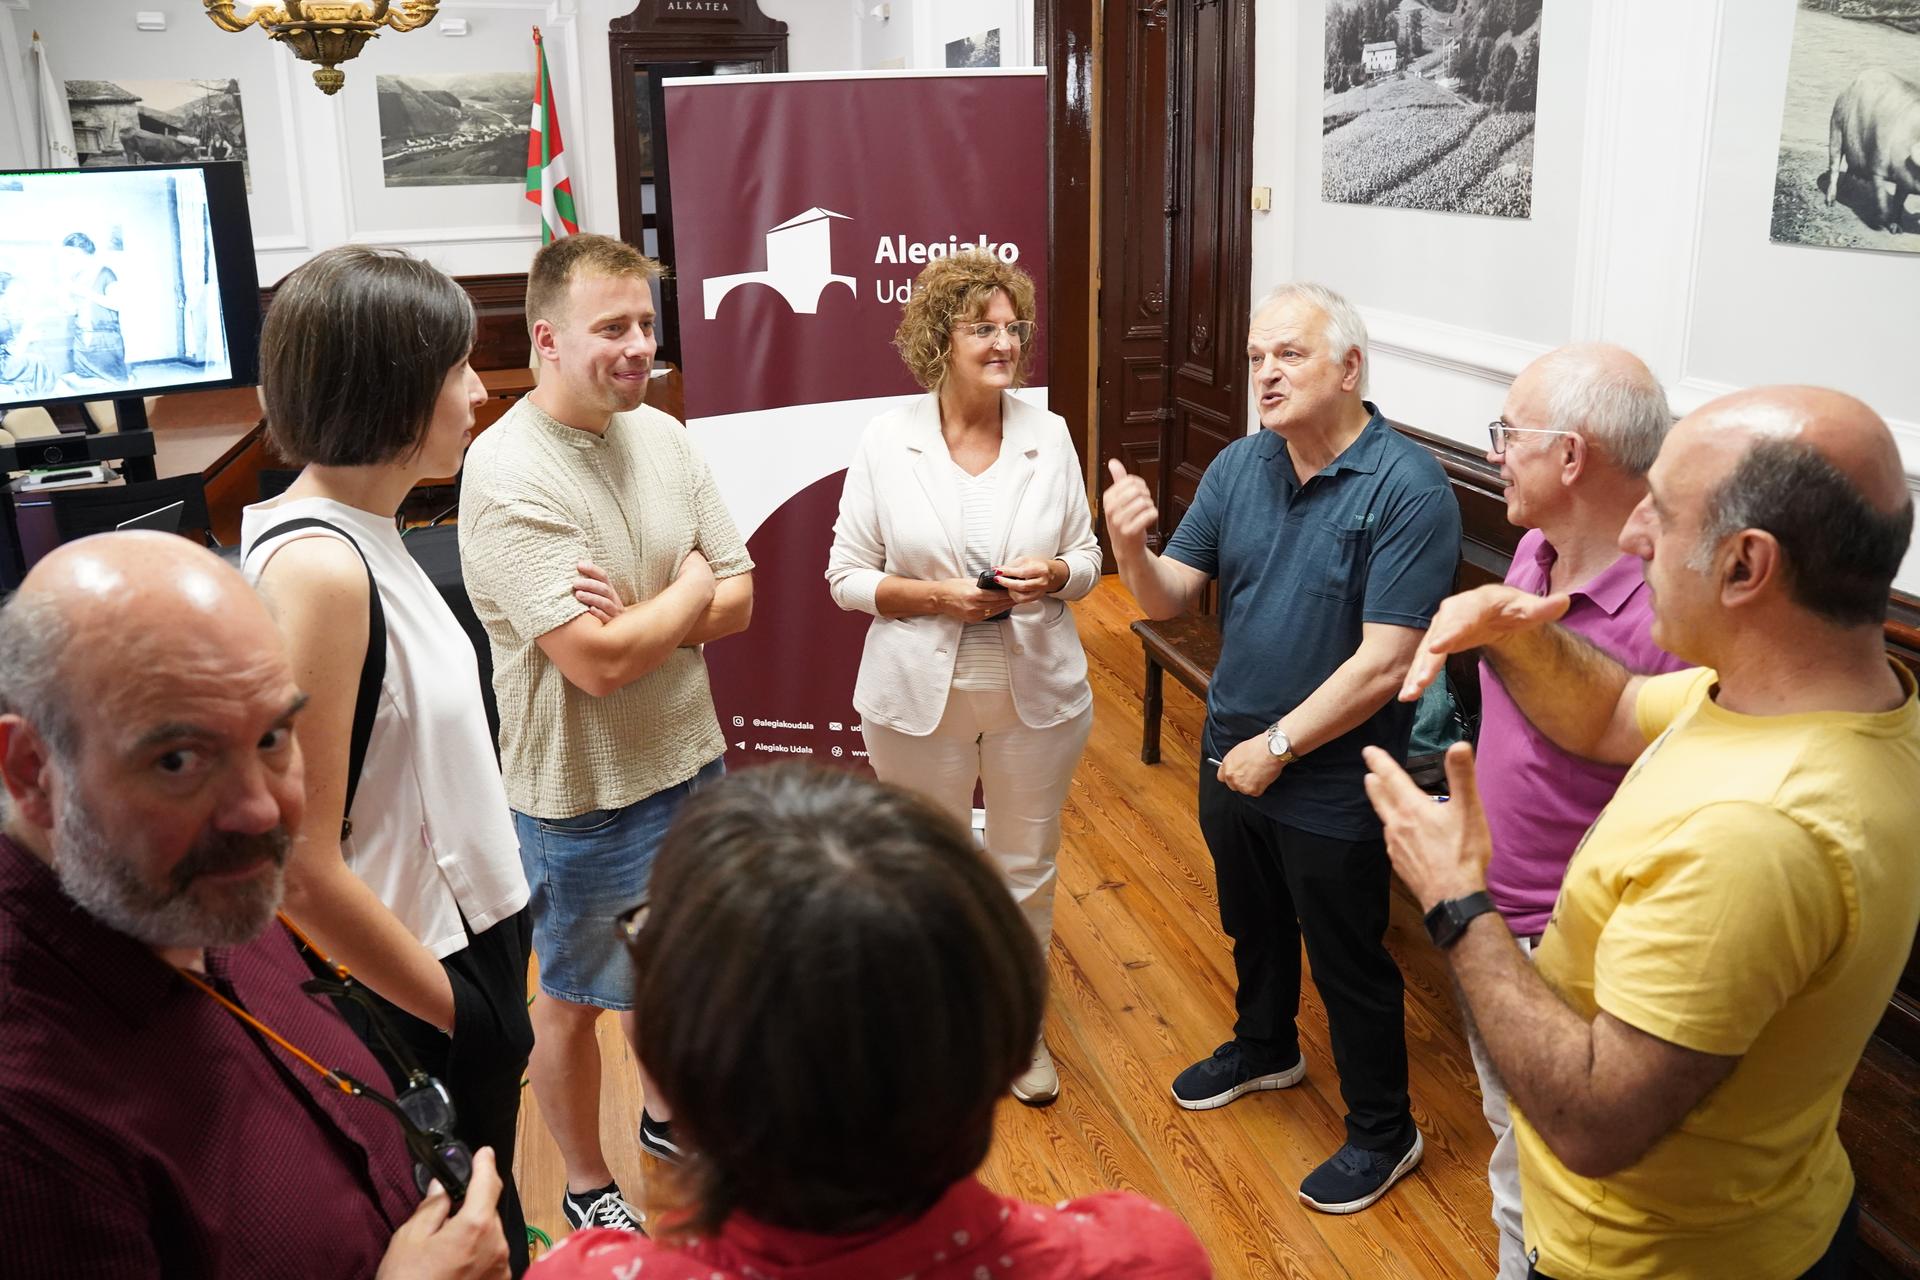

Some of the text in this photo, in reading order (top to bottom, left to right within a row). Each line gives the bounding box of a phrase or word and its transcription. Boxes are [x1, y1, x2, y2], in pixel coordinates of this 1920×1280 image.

[667, 1, 729, 11] ALKATEA
[752, 718, 815, 731] @alegiakoudala
[754, 742, 813, 754] Alegiako Udala
